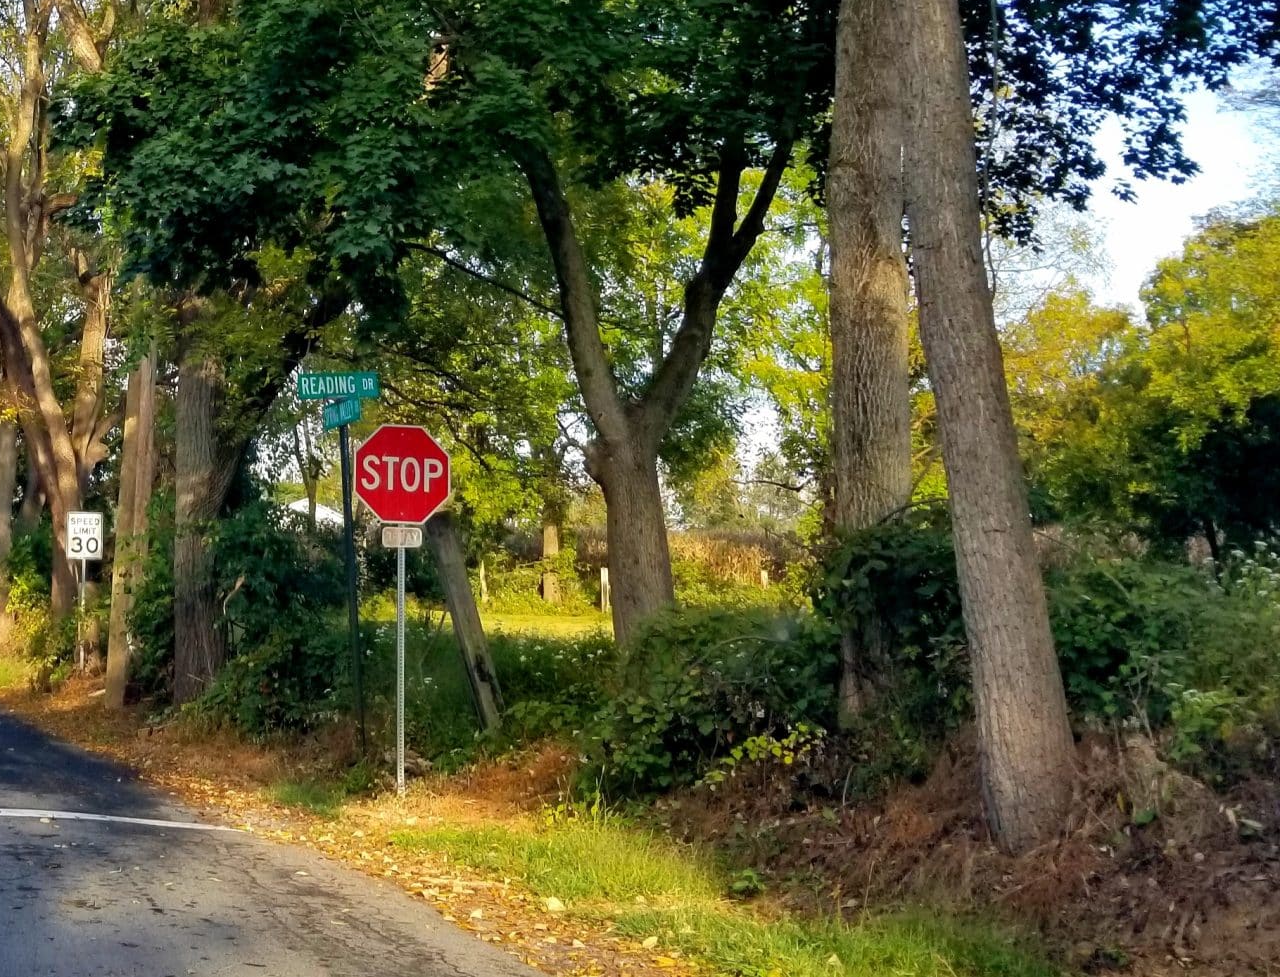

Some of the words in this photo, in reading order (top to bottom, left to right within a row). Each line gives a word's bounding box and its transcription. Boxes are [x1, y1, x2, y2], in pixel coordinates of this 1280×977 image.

[301, 375, 356, 395] READING
[361, 377, 374, 391] DR
[361, 454, 443, 493] STOP
[70, 517, 100, 526] SPEED
[73, 527, 97, 535] LIMIT
[70, 536, 99, 554] 30
